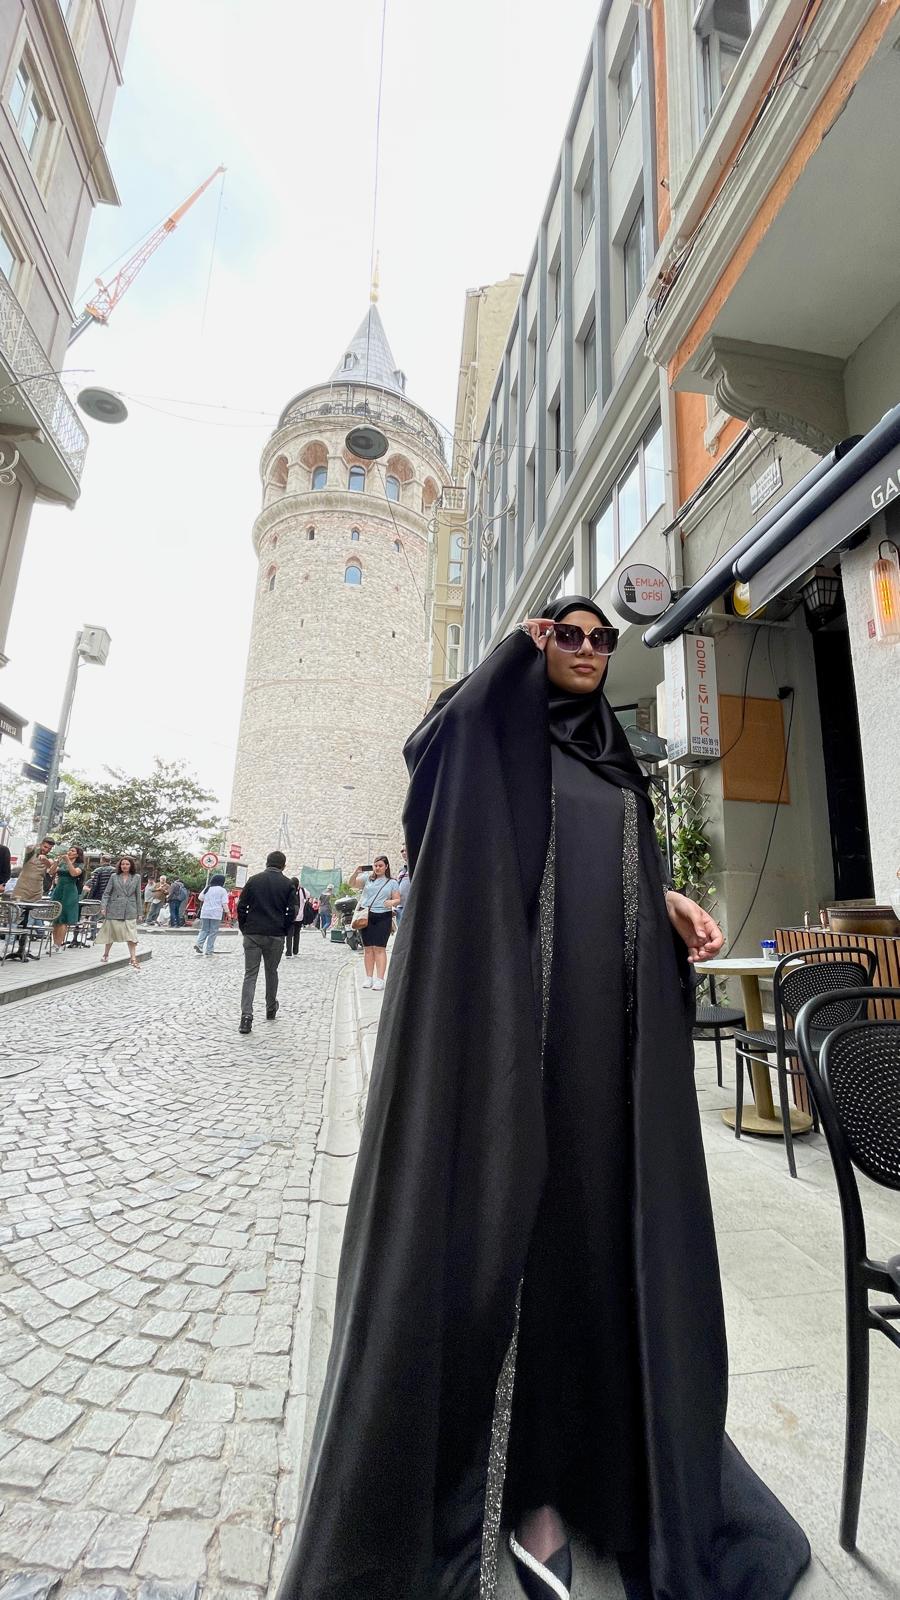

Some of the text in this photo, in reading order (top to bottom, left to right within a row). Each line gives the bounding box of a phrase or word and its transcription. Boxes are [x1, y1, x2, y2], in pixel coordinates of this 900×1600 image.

[871, 469, 900, 509] GA
[635, 577, 664, 588] EMLAK
[641, 589, 663, 602] OFİSİ
[696, 640, 709, 736] DOST EMLAK
